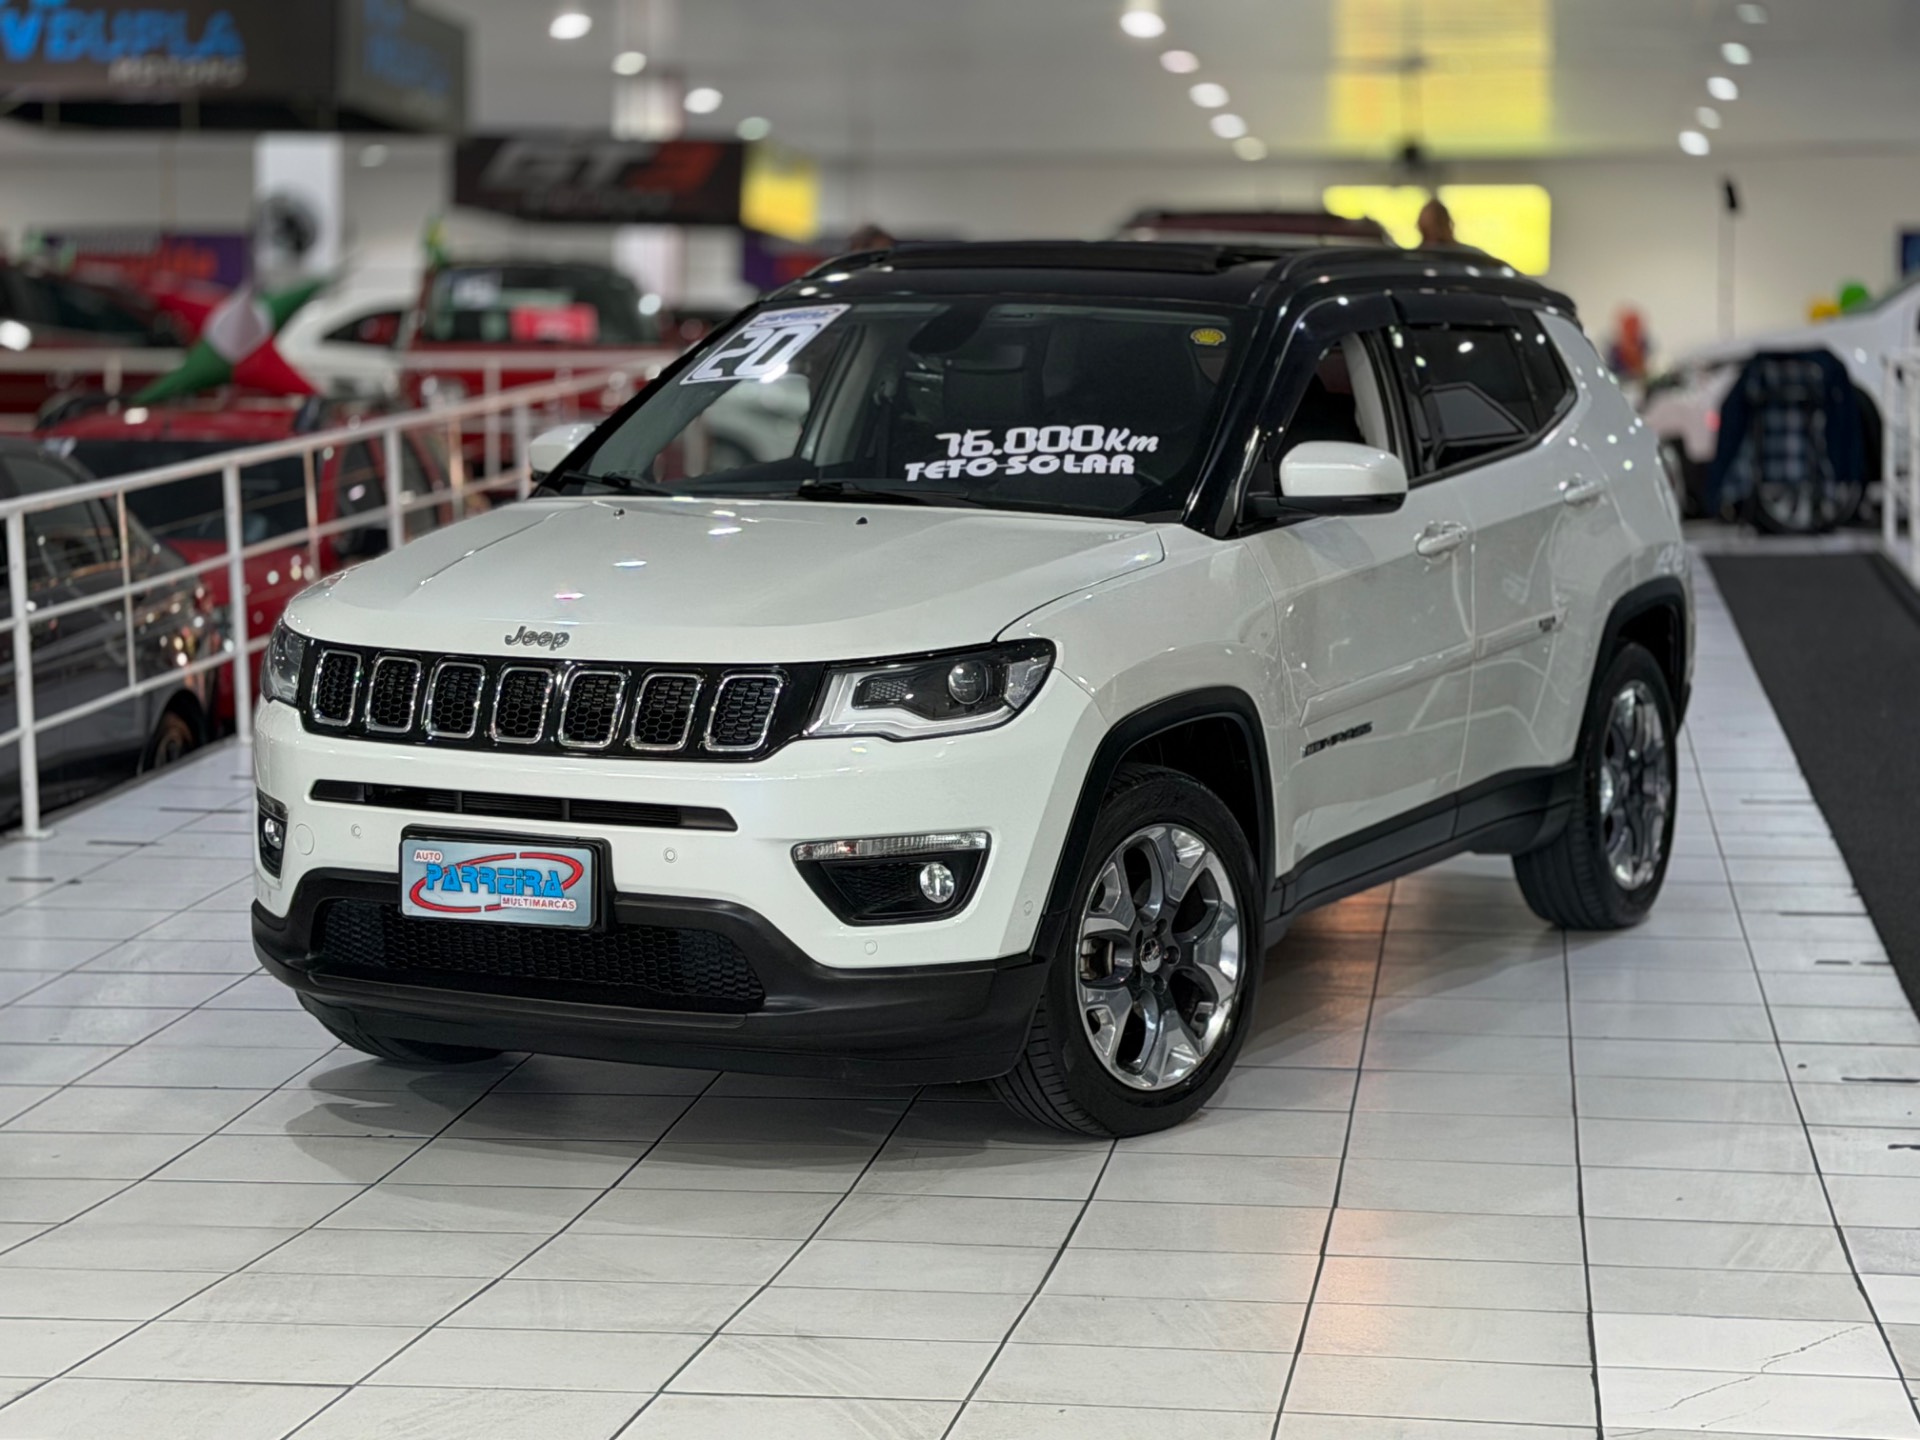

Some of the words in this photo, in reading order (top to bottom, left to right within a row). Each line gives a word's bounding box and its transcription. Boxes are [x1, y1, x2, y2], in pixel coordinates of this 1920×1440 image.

[692, 324, 819, 380] 20
[905, 457, 998, 482] TETO
[1004, 453, 1135, 476] SOLAR
[504, 625, 570, 651] Jeep
[415, 851, 442, 861] AUTO
[426, 863, 564, 898] PARREIRA
[501, 897, 576, 910] MULTIMARCAS
